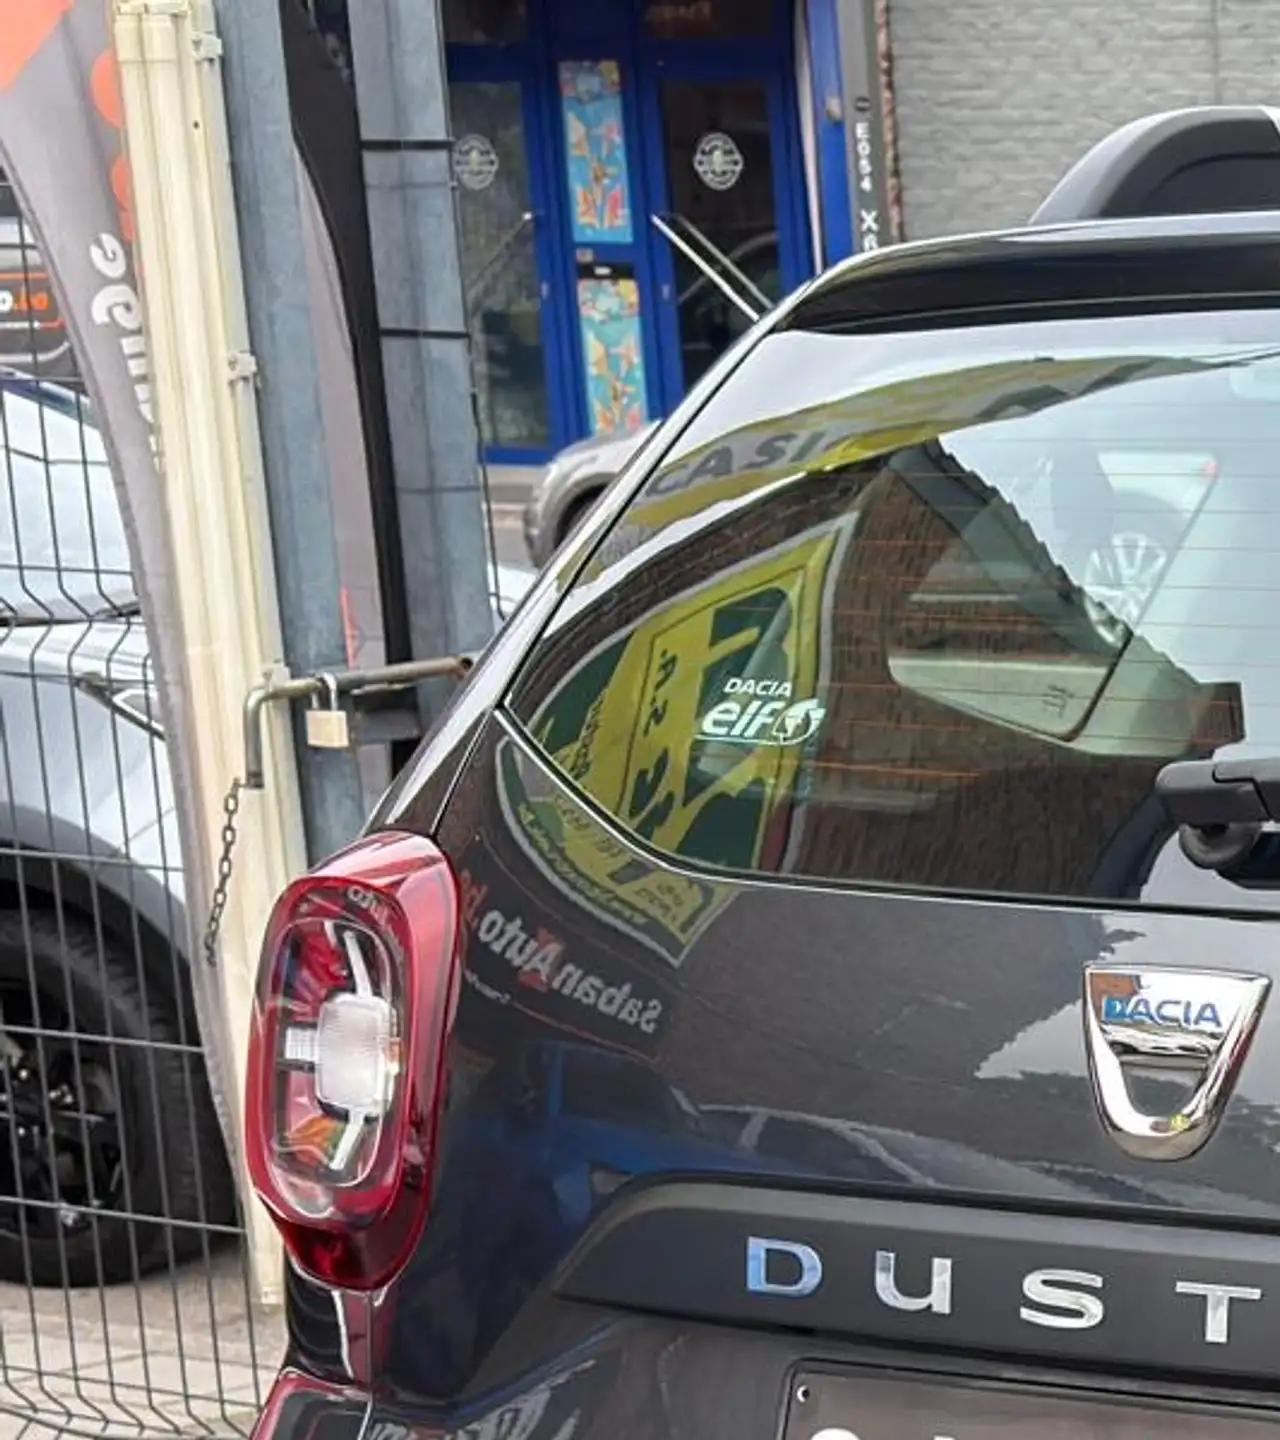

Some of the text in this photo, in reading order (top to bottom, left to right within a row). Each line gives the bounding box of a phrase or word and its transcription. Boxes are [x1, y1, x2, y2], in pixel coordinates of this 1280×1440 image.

[724, 677, 793, 698] DACIA
[701, 699, 788, 738] elf
[1103, 996, 1223, 1029] DACIA
